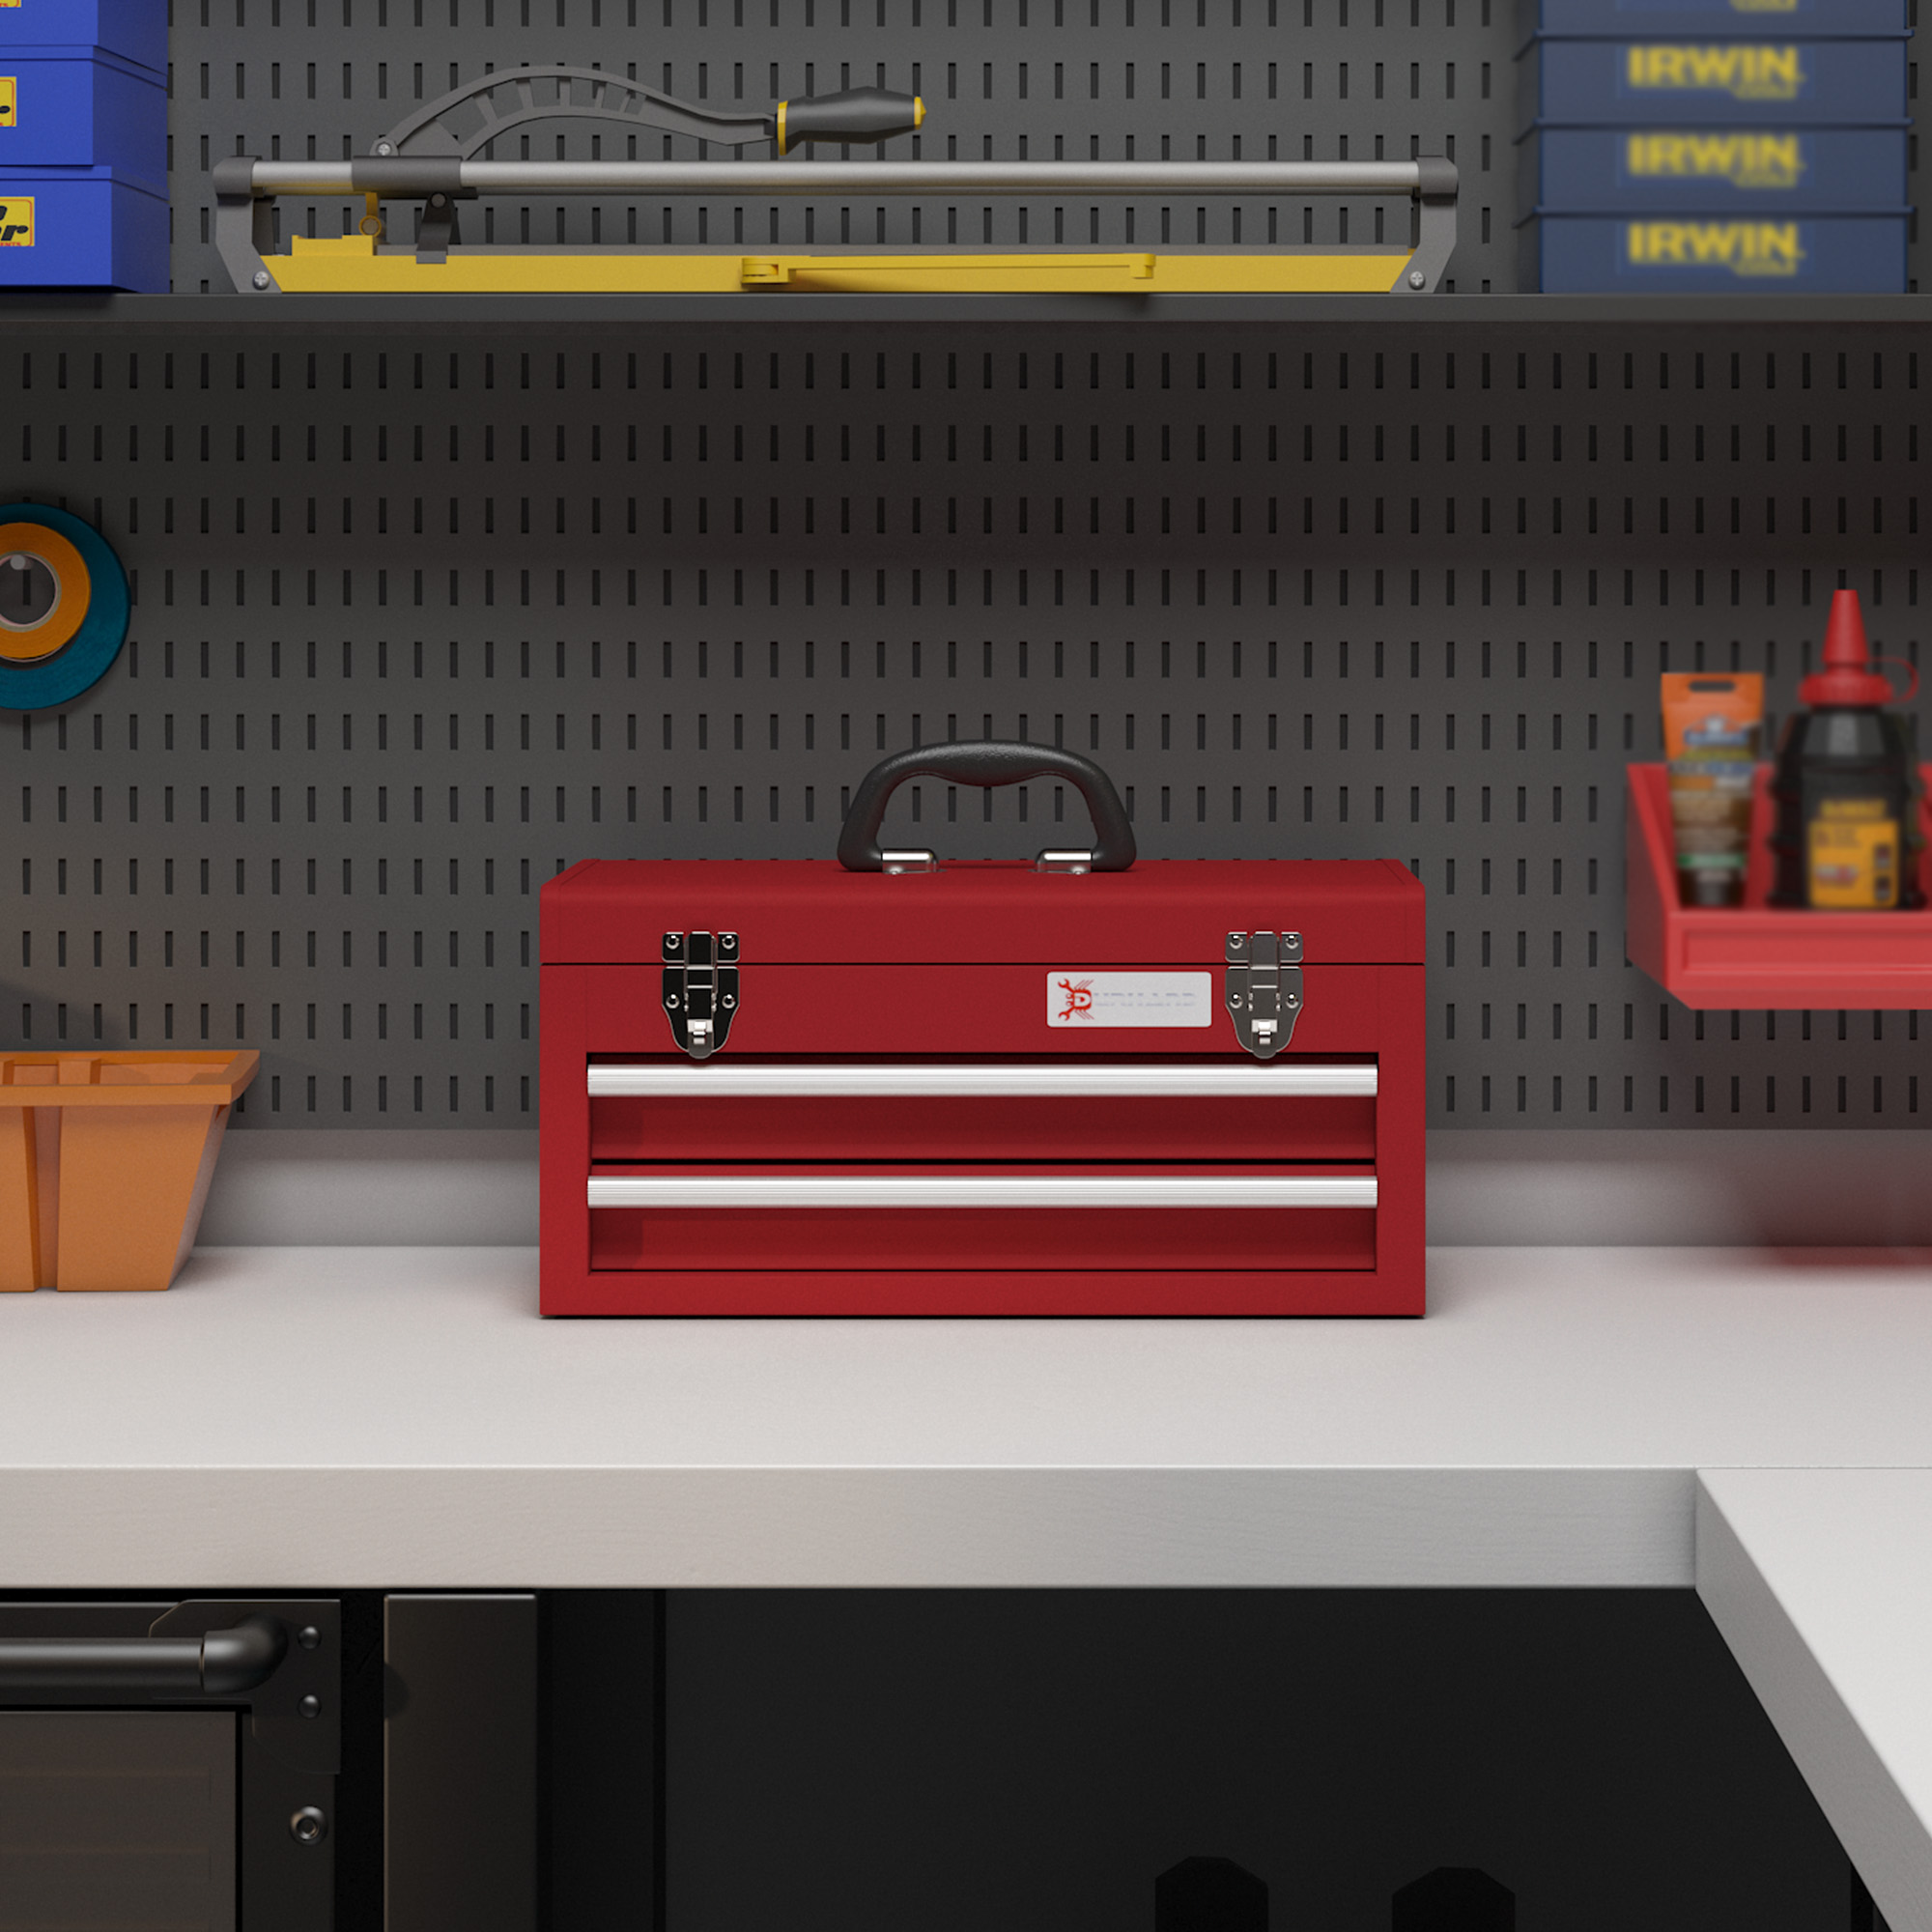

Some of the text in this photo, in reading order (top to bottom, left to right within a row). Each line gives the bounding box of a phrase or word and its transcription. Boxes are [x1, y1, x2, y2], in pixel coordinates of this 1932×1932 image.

[1628, 45, 1800, 87] IRWIN
[1628, 133, 1800, 176] IRWIN
[1628, 222, 1800, 264] IRWIN
